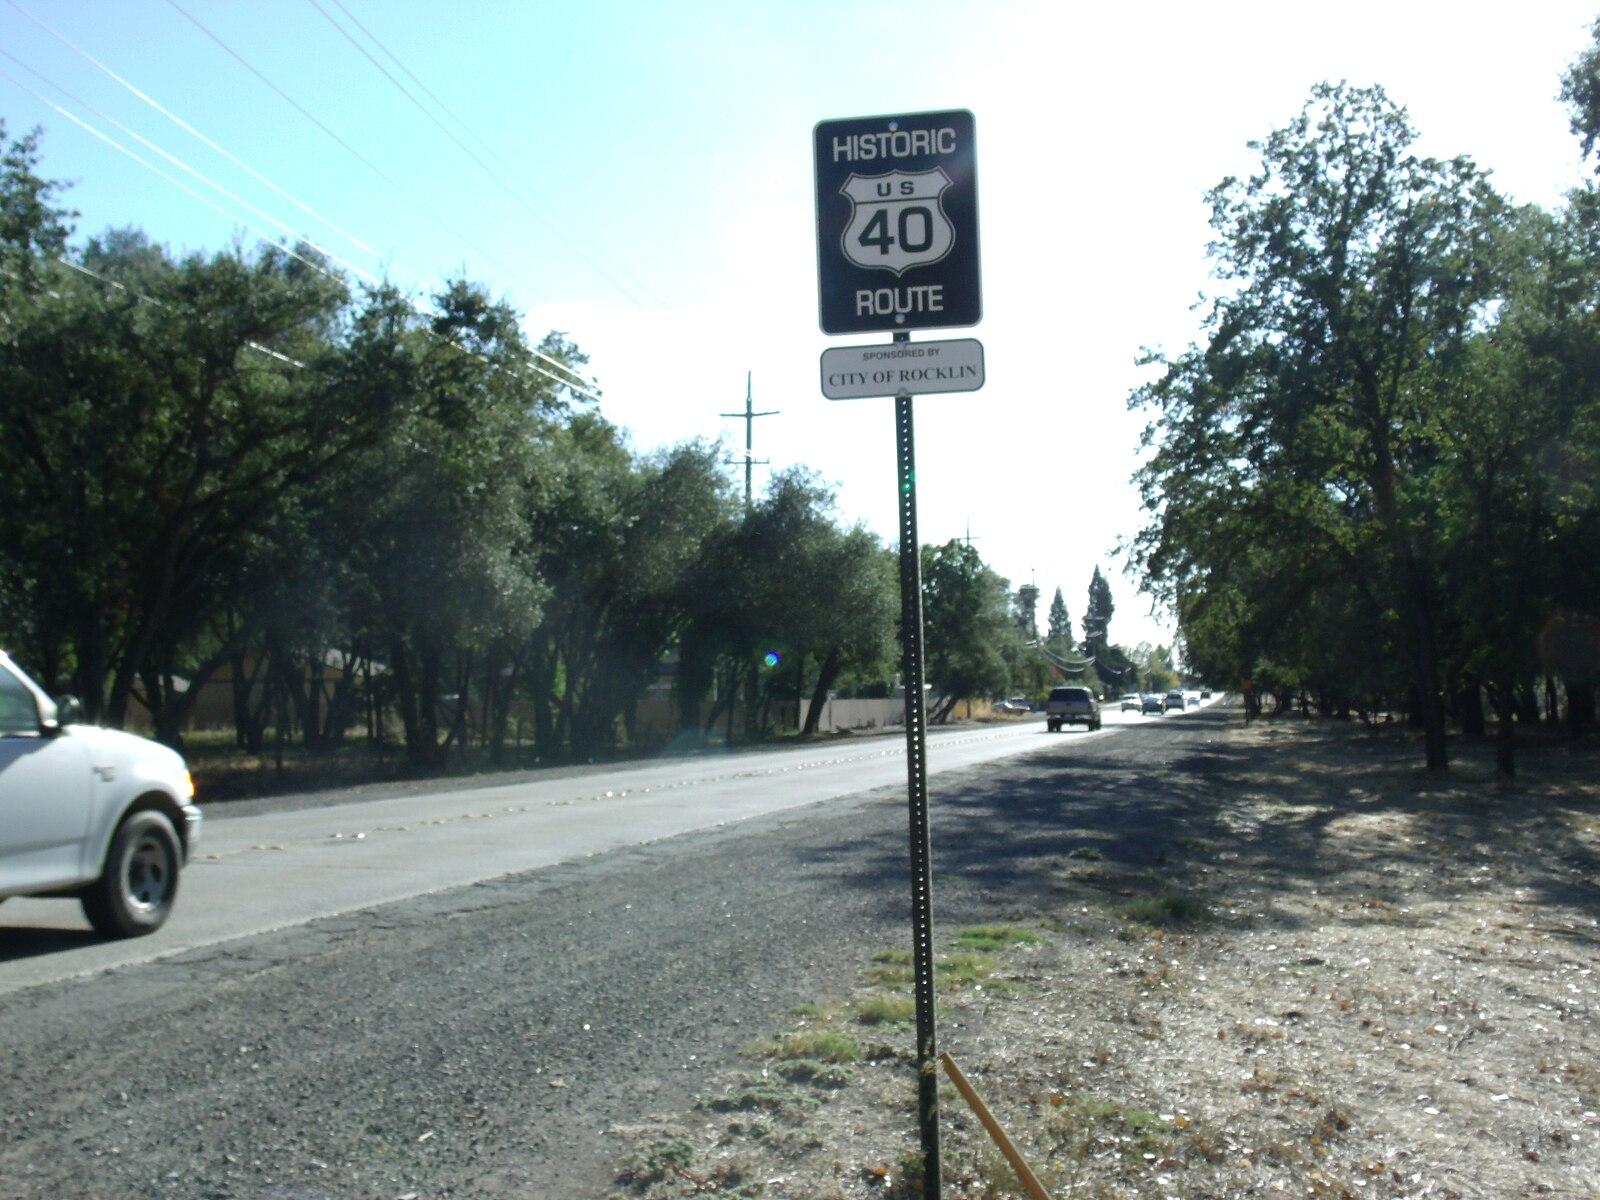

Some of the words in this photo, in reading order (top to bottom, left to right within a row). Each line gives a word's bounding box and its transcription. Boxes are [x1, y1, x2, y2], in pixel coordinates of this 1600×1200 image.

[833, 128, 956, 162] HISTORIC
[858, 206, 933, 255] 40
[856, 285, 943, 316] ROUTE
[863, 349, 924, 361] SPONSORED
[928, 348, 940, 357] BY
[829, 373, 869, 387] CITY
[873, 370, 895, 383] OF
[900, 365, 976, 382] ROCKLIN
